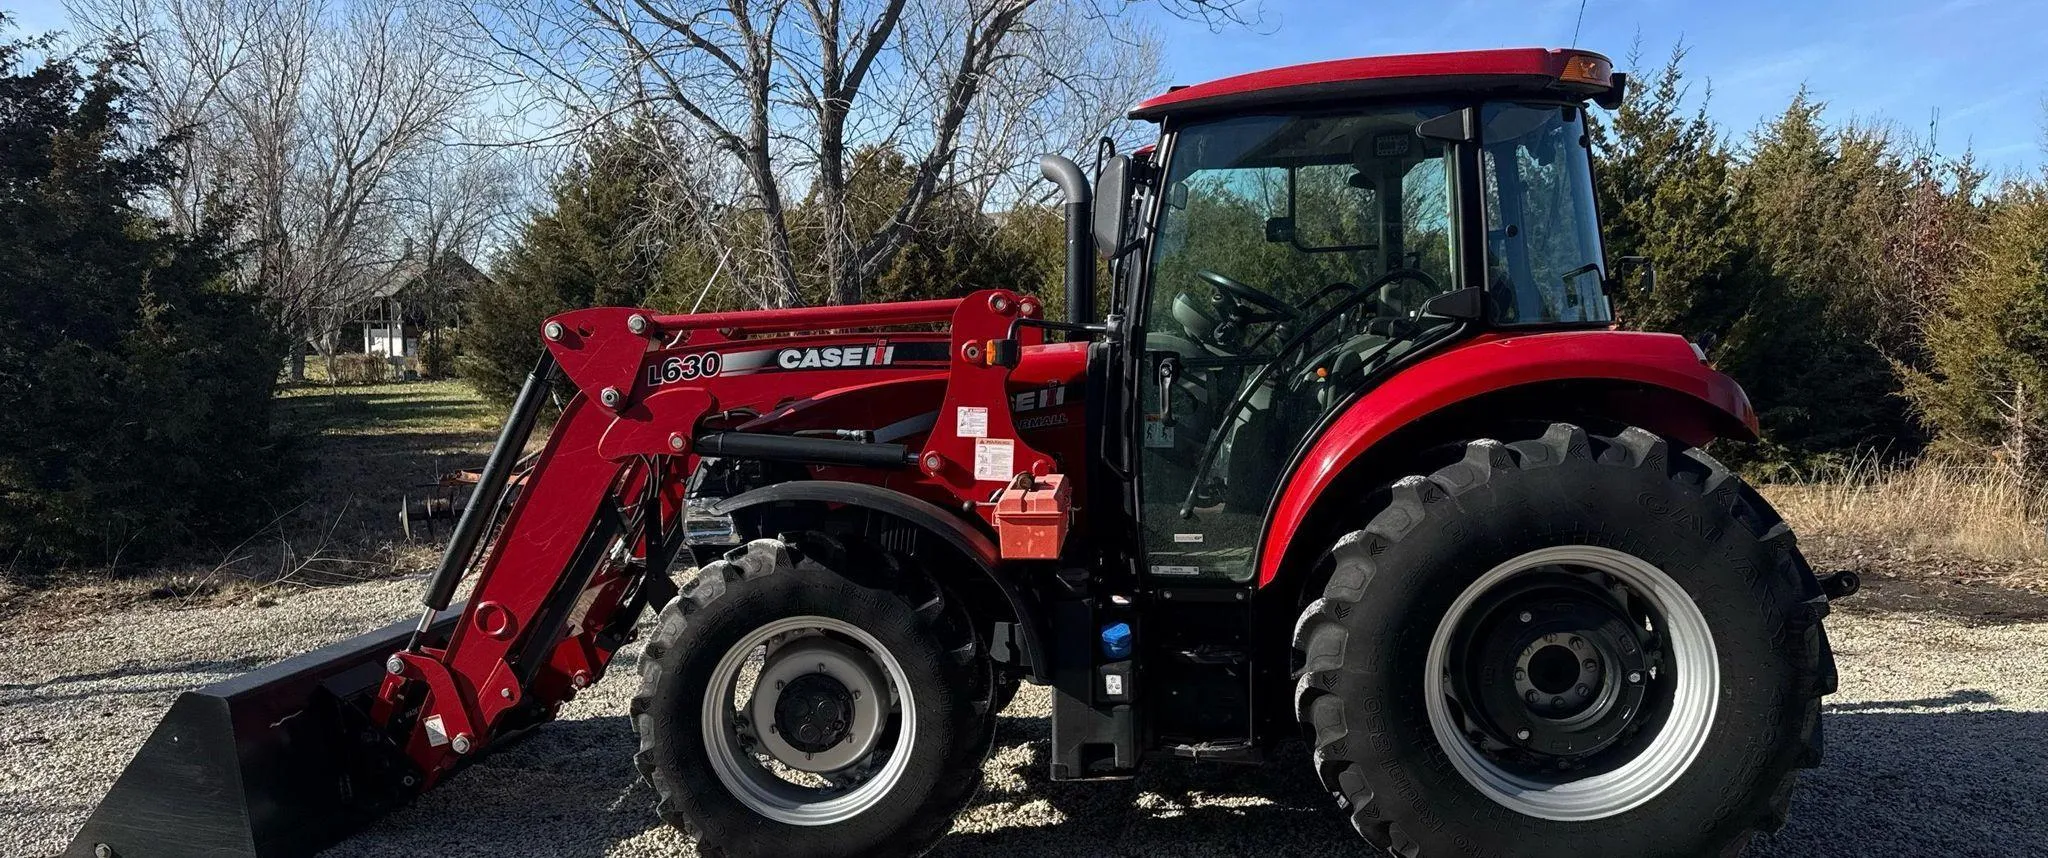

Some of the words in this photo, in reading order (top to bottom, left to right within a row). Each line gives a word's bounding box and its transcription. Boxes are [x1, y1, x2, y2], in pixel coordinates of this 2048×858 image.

[648, 351, 722, 386] L630
[778, 347, 863, 369] CASE
[1363, 697, 1392, 752] 850
